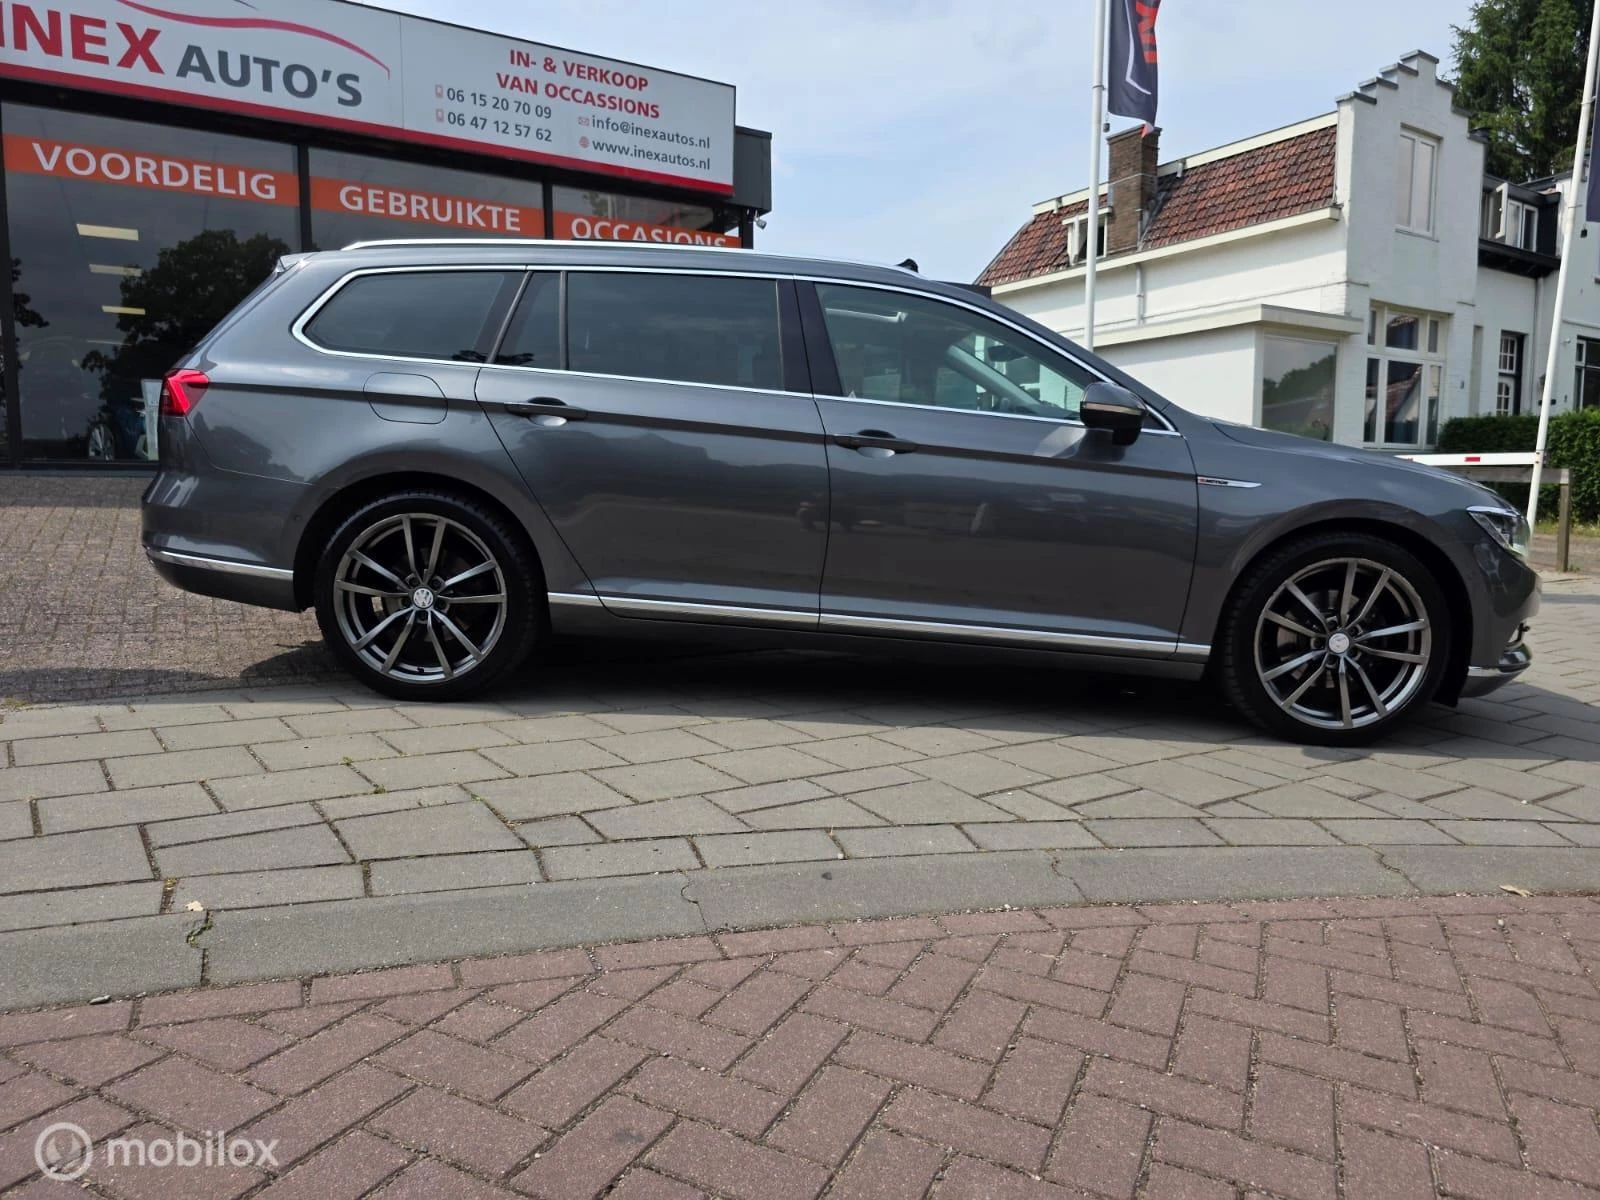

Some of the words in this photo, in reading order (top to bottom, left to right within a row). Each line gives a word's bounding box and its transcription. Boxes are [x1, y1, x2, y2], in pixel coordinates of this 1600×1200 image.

[176, 45, 362, 107] AUTO'S
[510, 49, 536, 67] IN-
[543, 57, 556, 73] &
[562, 61, 648, 91] VERKOOP
[447, 88, 464, 102] 06
[471, 93, 486, 107] 15
[492, 96, 509, 111] 20
[514, 101, 530, 115] 70
[535, 105, 552, 119] 09
[496, 72, 538, 94] VAN
[544, 83, 659, 118] OCCASSIONS
[448, 112, 465, 126] 06
[470, 116, 487, 130] 47
[493, 120, 509, 134] 12
[514, 124, 530, 138] 57
[536, 128, 552, 142] 62
[592, 115, 710, 149] info@inexautos.nl
[32, 142, 276, 199] VOORDELIG
[592, 140, 710, 170] www.inexautos.nl
[339, 185, 520, 231] GEBRUIKTE
